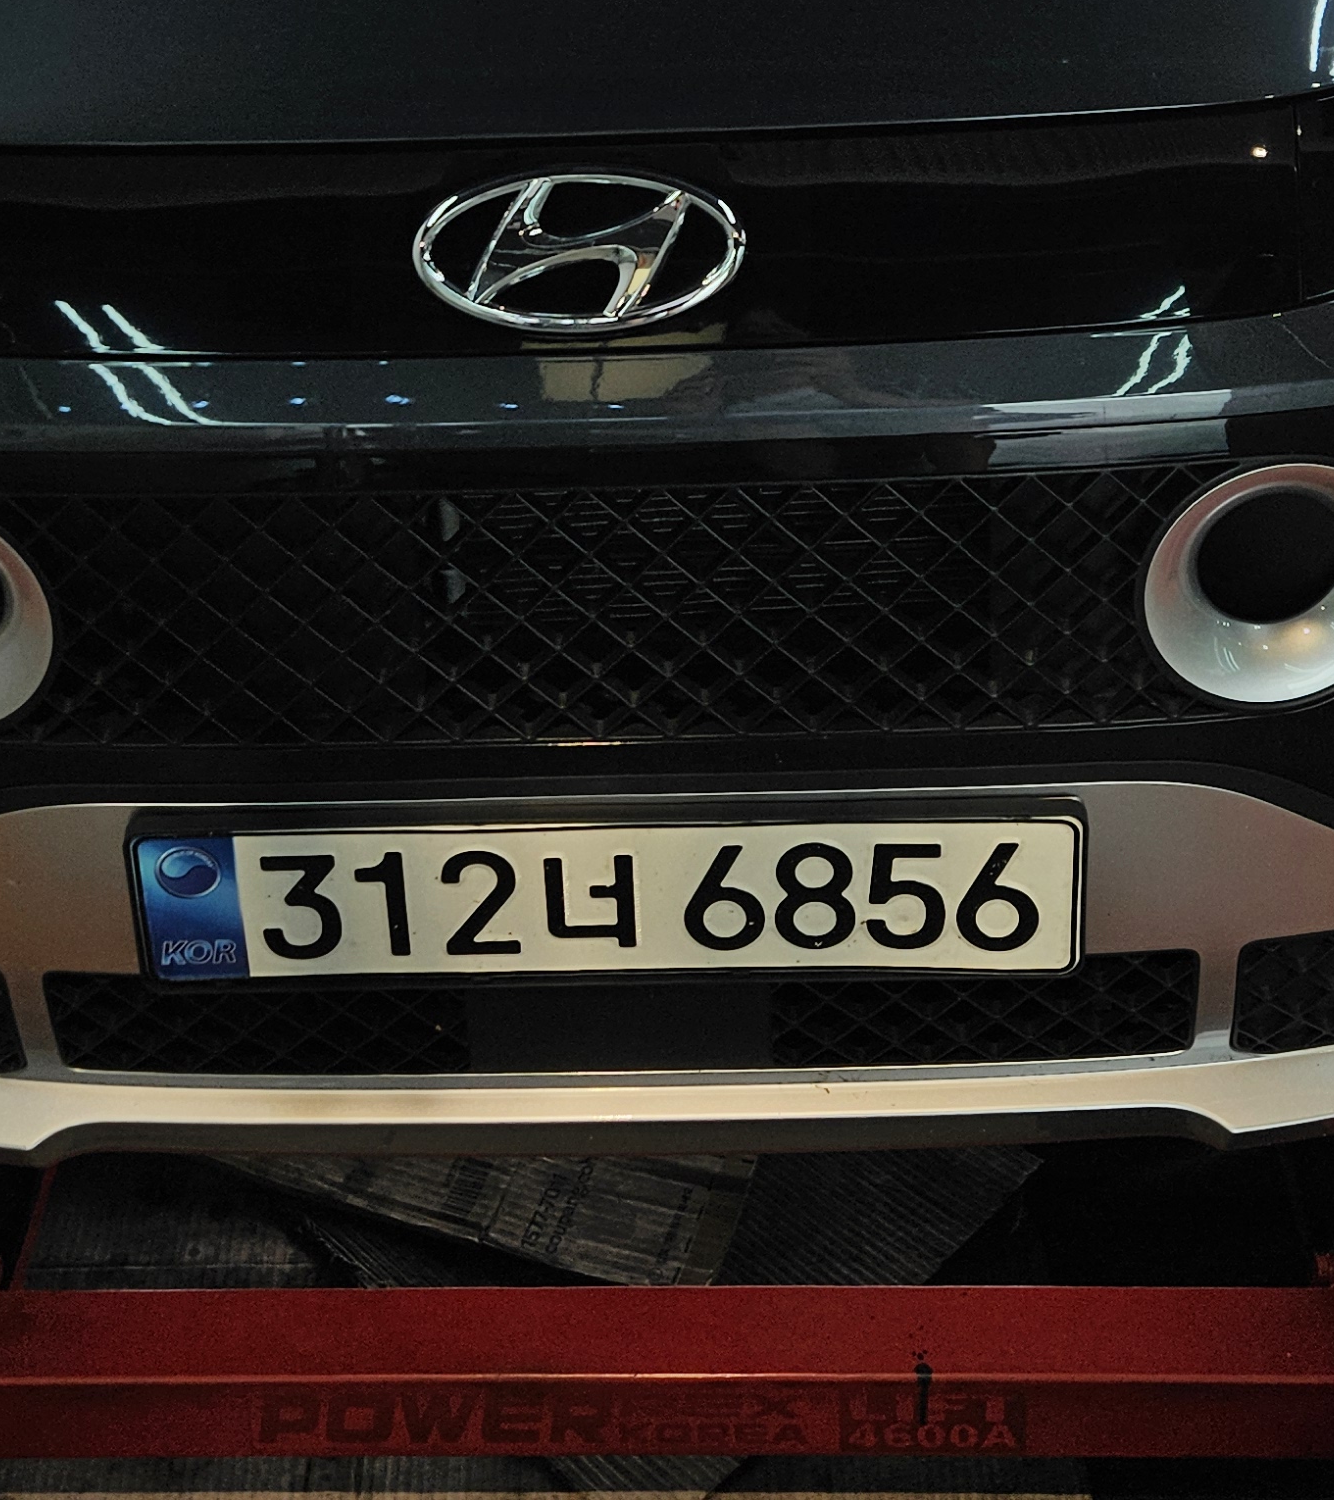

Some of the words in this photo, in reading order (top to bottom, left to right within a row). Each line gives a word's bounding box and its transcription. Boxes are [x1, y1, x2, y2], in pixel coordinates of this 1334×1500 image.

[259, 850, 637, 960] 312너
[684, 841, 1040, 952] 6856
[160, 939, 238, 966] KOR
[848, 1423, 1016, 1448] 4600A
